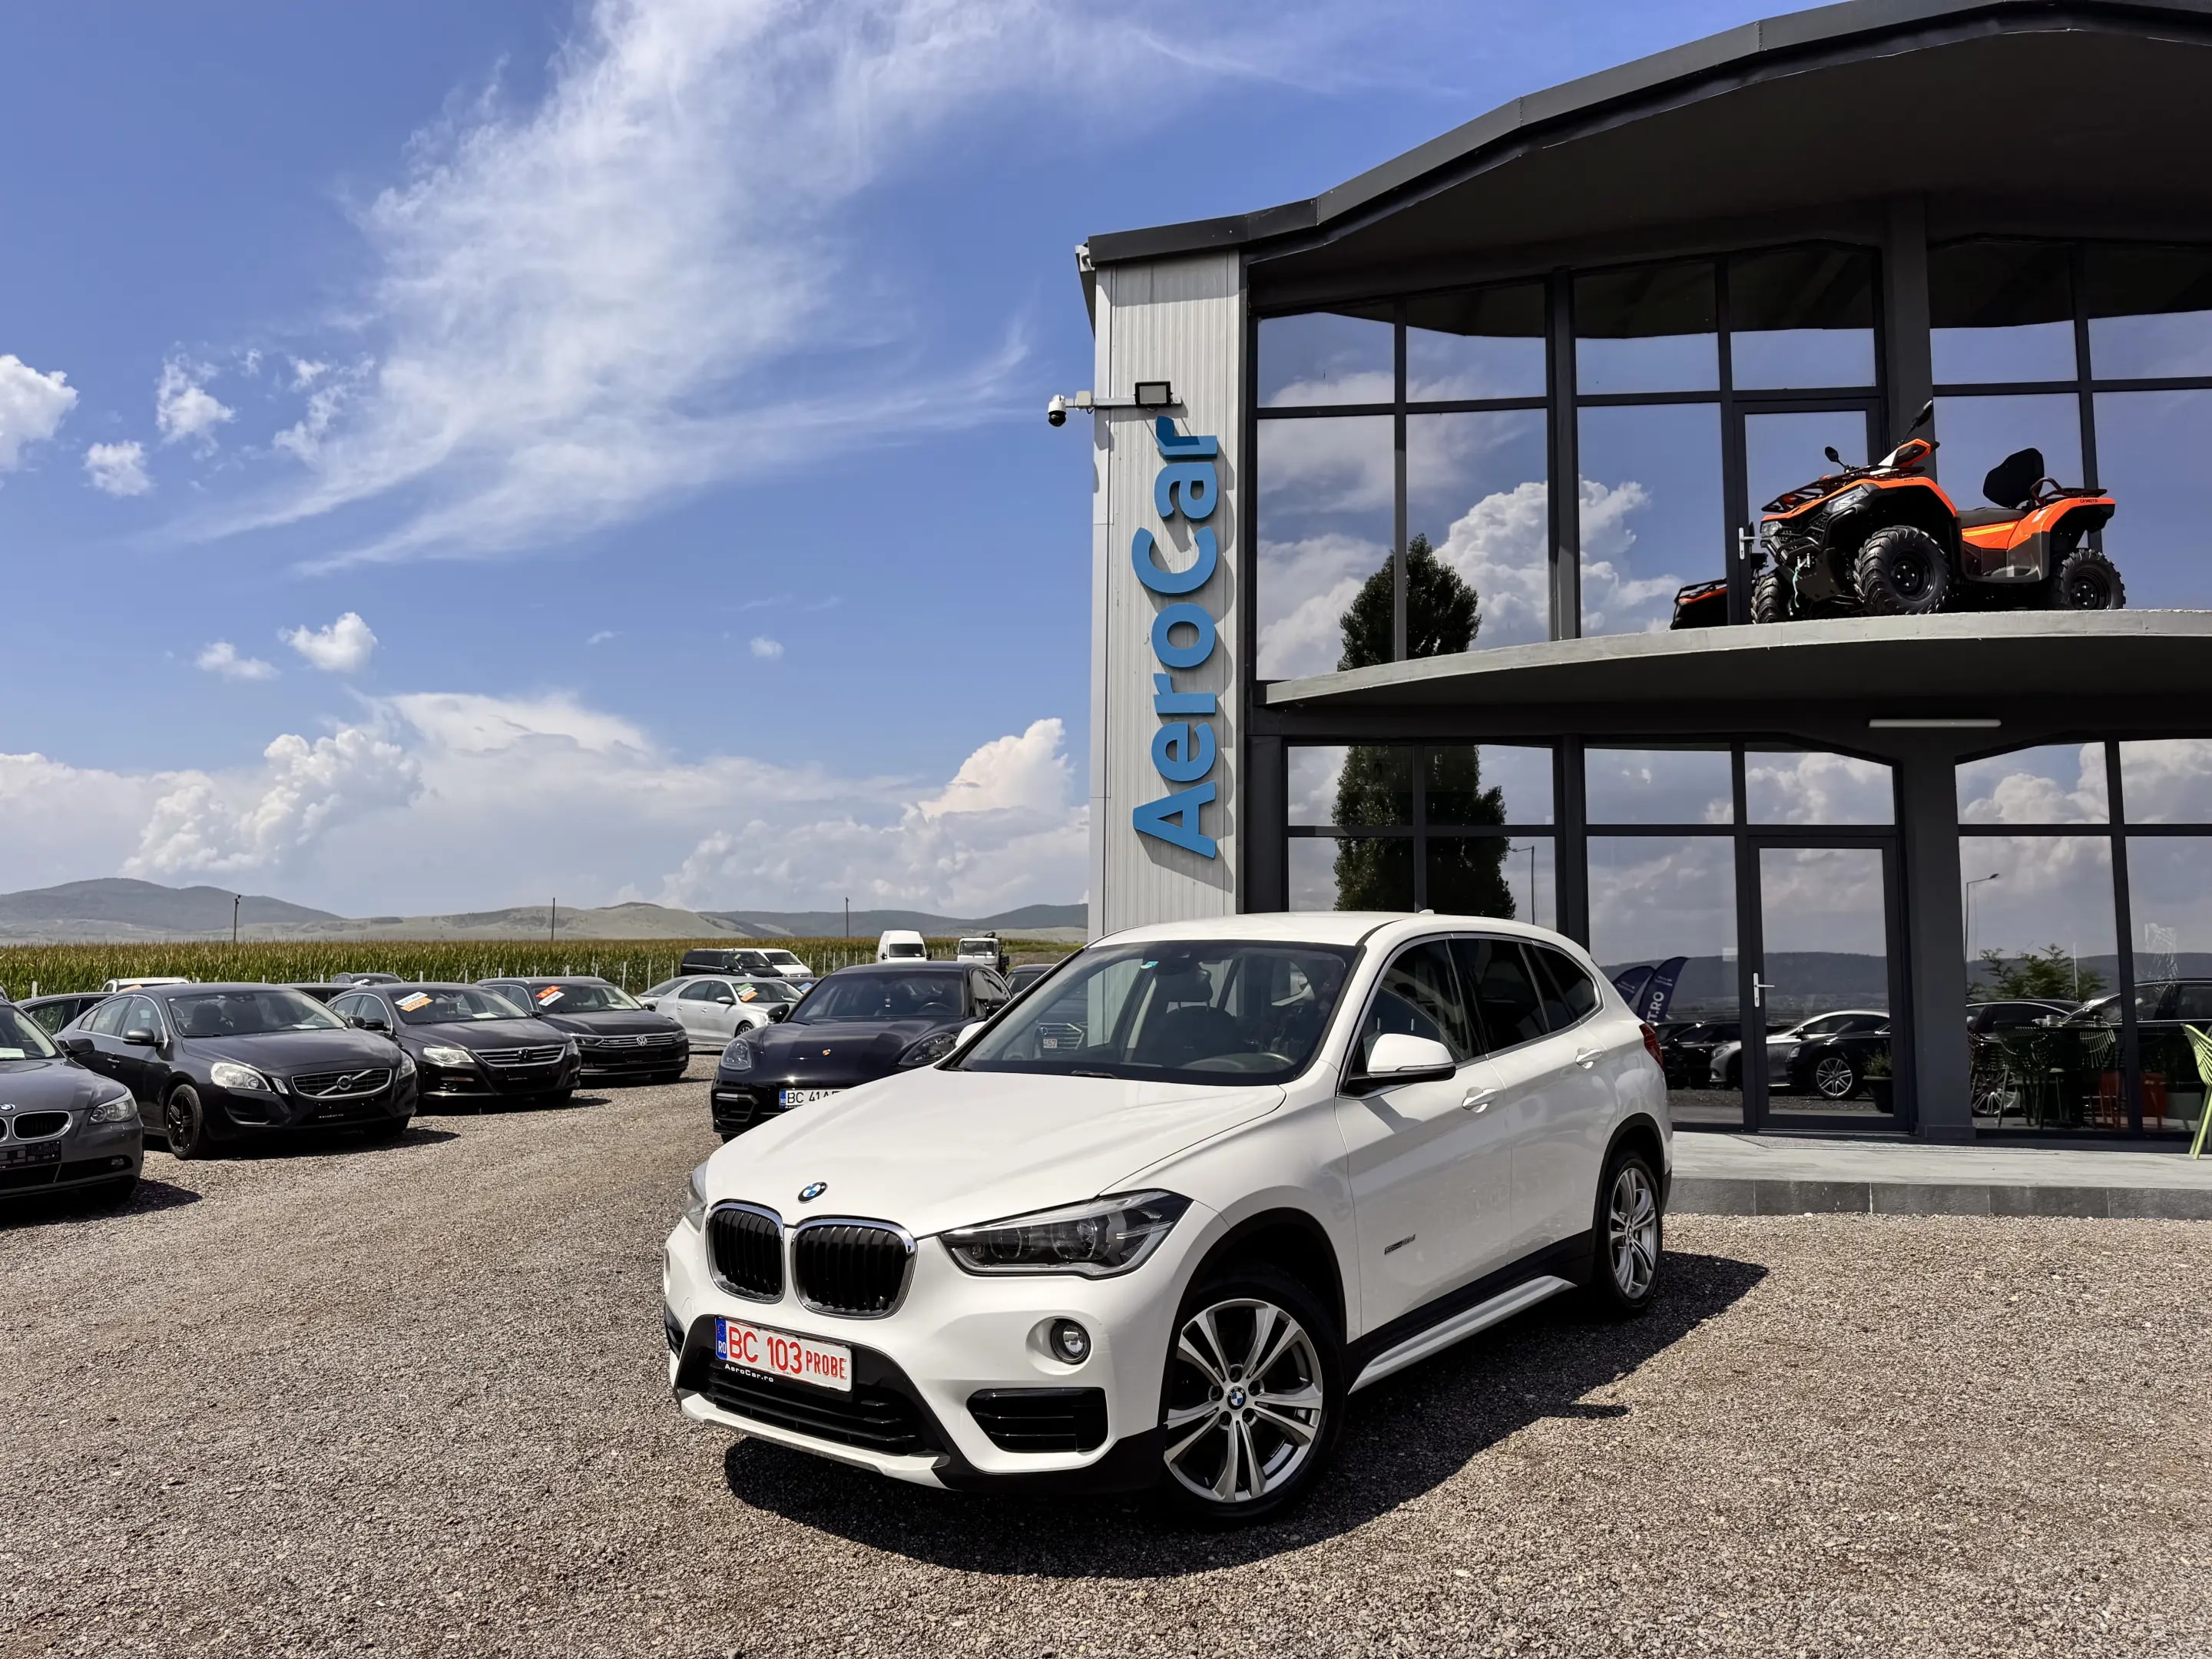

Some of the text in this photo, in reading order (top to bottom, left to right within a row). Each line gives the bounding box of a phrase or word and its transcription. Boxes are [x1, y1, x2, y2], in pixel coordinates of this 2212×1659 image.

[1131, 416, 1218, 859] AeroCar
[787, 1092, 804, 1103] BC
[718, 1326, 846, 1379] RO BC 103 PROBE
[724, 1363, 774, 1382] AeroCar.ro
